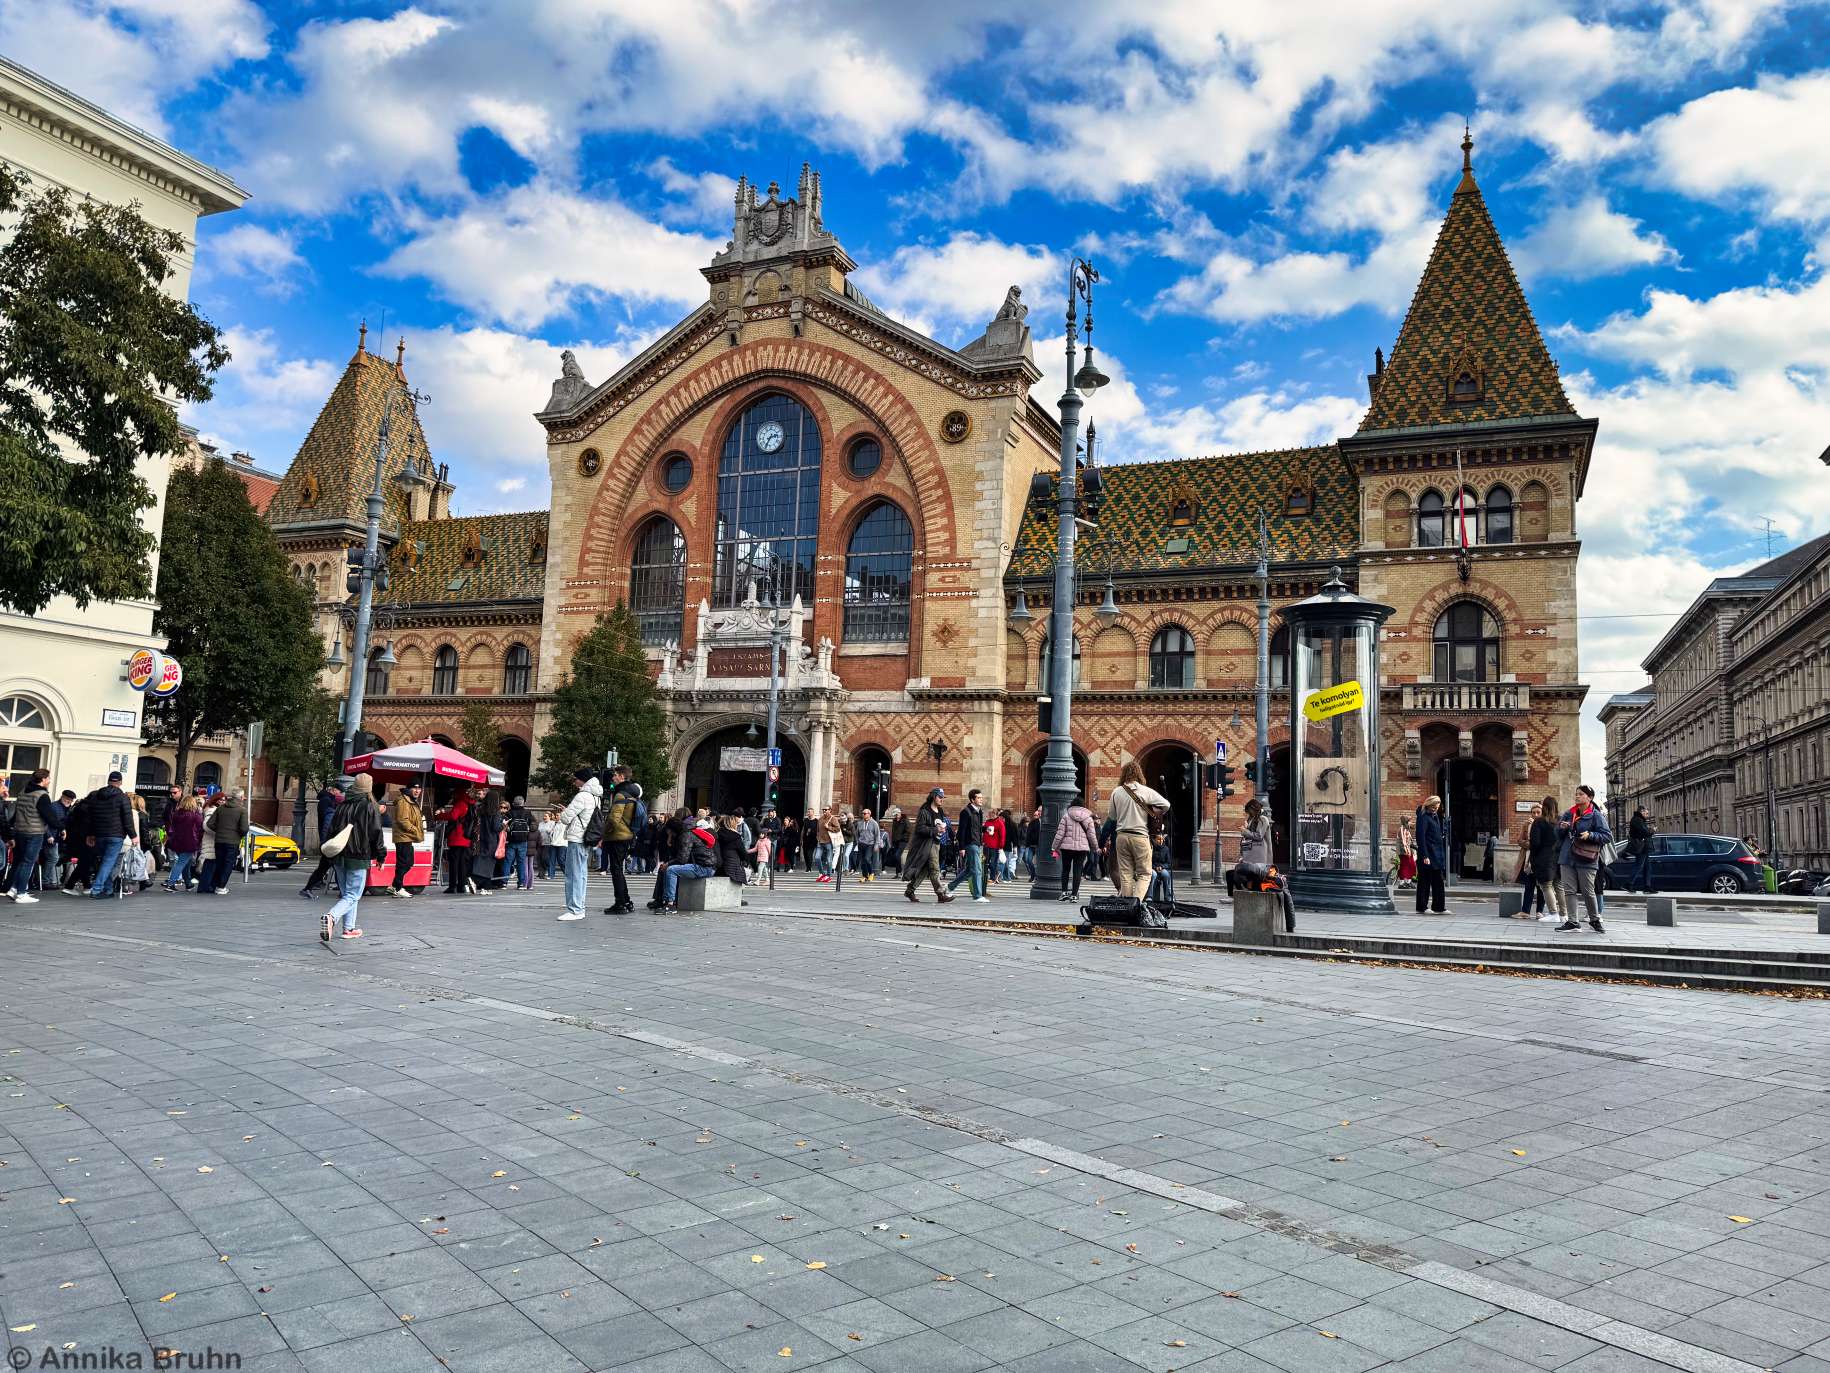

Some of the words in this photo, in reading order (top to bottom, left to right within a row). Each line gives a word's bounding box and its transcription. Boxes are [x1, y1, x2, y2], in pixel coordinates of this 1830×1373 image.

[130, 657, 152, 669] BURGER
[130, 664, 153, 680] KING
[1310, 700, 1320, 708] Te
[1320, 688, 1359, 705] komolyan
[383, 761, 420, 769] INFORMATION
[441, 766, 466, 776] BUDAPEST
